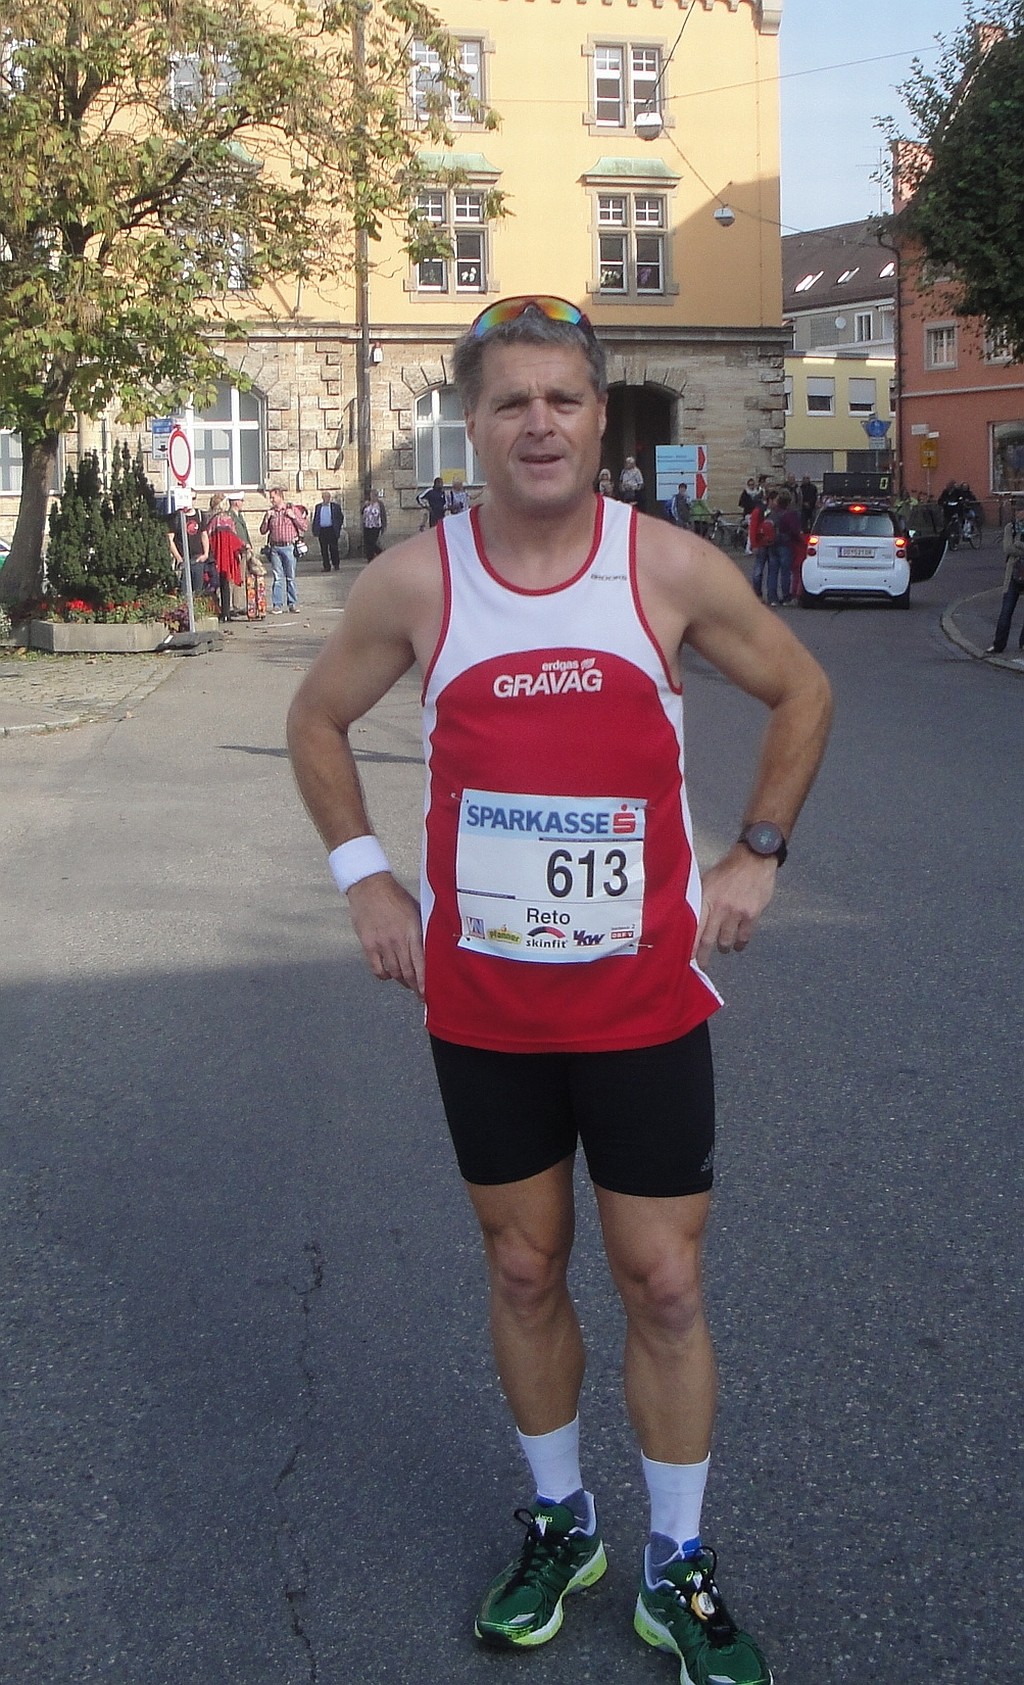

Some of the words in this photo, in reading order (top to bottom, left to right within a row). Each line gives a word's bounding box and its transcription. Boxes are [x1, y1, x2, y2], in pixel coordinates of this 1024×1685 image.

[542, 659, 579, 672] erdgas
[493, 669, 603, 698] GRAVAG
[466, 804, 610, 834] SPARKASSE
[546, 849, 629, 898] 613
[526, 907, 571, 925] Reto
[526, 938, 566, 949] skinfit
